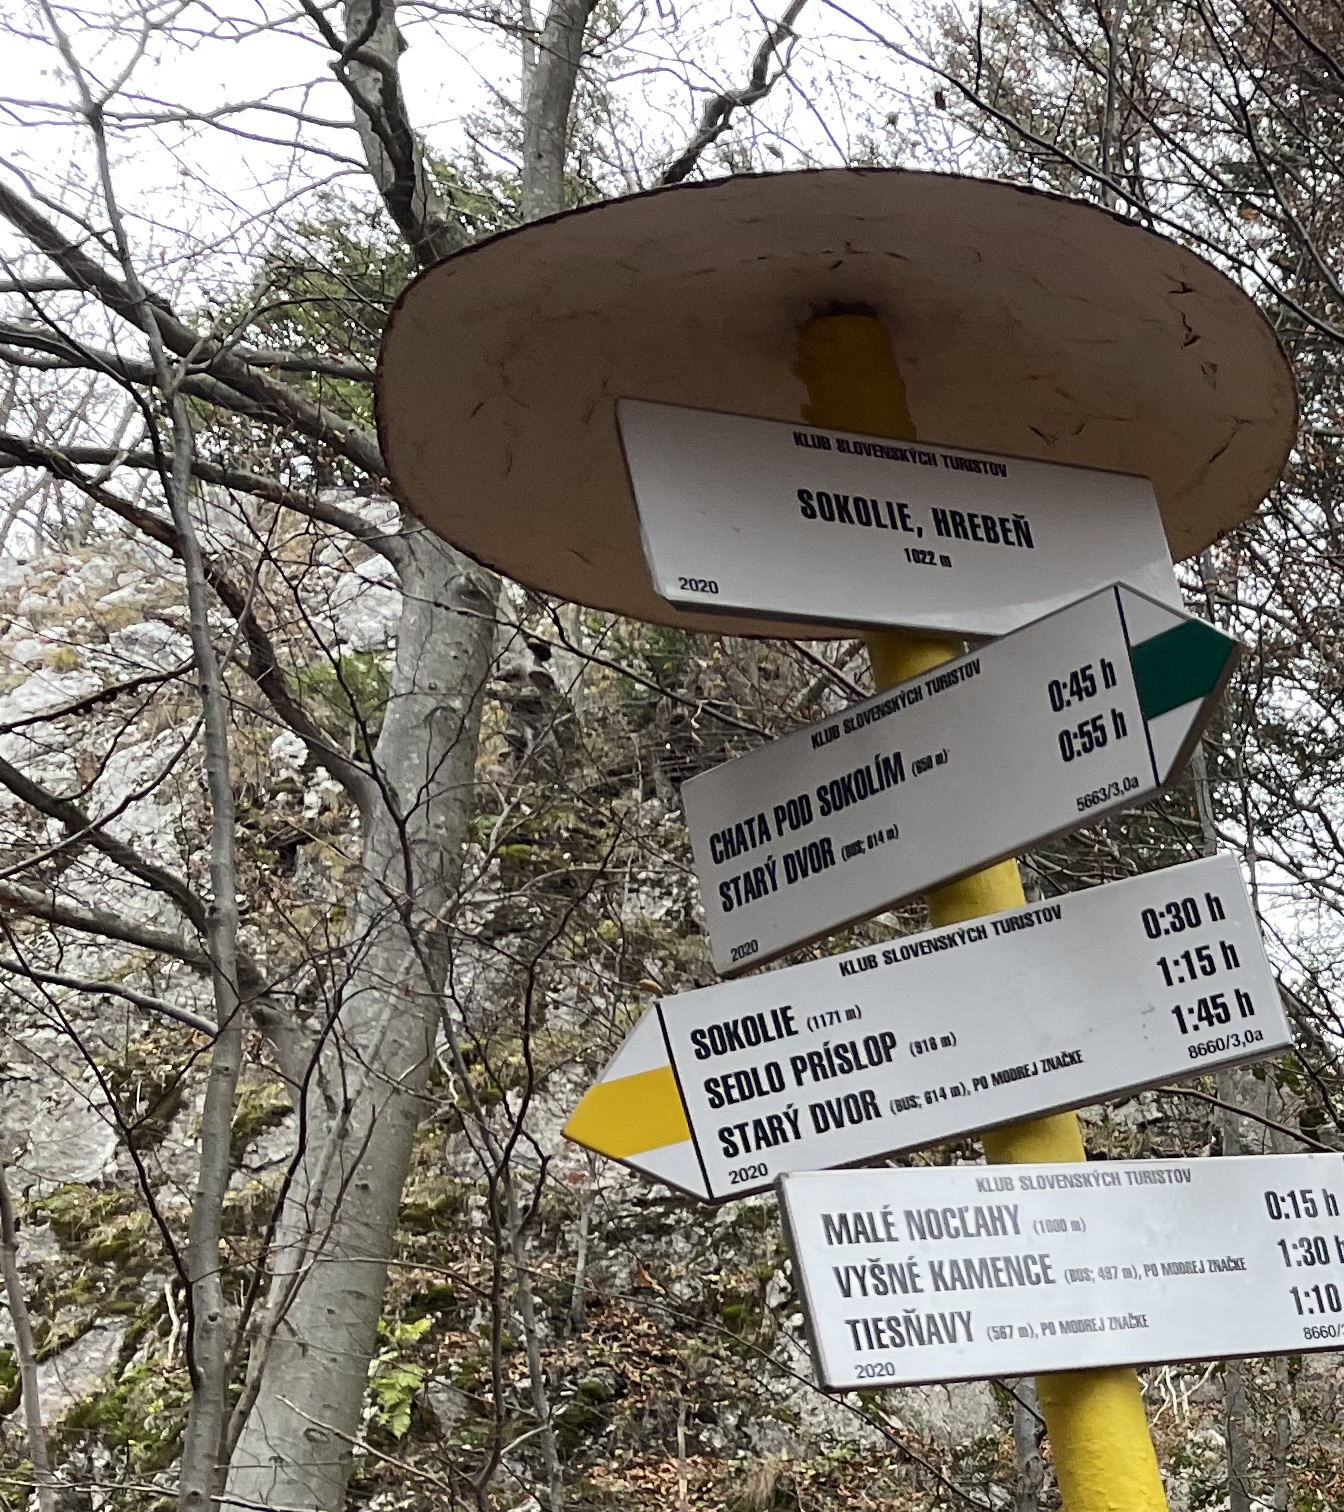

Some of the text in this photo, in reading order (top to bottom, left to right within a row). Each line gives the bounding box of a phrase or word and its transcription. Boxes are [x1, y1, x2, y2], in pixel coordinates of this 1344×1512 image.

[793, 431, 1007, 477] KLUB SLOVENSKÝCH TURISTOV
[797, 488, 1034, 548] SOKOLIE, HREBEŇ
[904, 548, 952, 568] 1022 m
[678, 576, 719, 594] 2020
[811, 658, 981, 750] KLUB SLOVENSKÝCH TURISTOV
[1048, 658, 1117, 712] 0:45 h
[1058, 708, 1128, 762] 0:55 h
[709, 812, 772, 865] CHATA
[773, 794, 813, 837] POD
[816, 751, 906, 817] SOKOLÍM
[1076, 776, 1140, 812] 5663/3,0a
[719, 855, 779, 912] STARÝ
[783, 837, 836, 884] DVOR
[1141, 892, 1226, 939] 0:30 h
[730, 939, 760, 962] 2020
[839, 904, 1062, 977] KLUB SLOVENSKÝCH TURISTOV
[1156, 940, 1240, 987] 1:15 h
[690, 1005, 799, 1060] SOKOLIE
[806, 1010, 842, 1032] (1171
[1171, 988, 1255, 1034] 1:45 h
[1188, 1029, 1264, 1059] 8660/3,0a
[704, 1061, 786, 1109] SEDLO
[789, 1031, 897, 1087] PRÍSLOP
[718, 1102, 802, 1158] STARÝ
[808, 1089, 882, 1134] DVOR
[972, 1077, 989, 1092] PO
[990, 1062, 1038, 1088] MODREJ
[1040, 1049, 1085, 1074] ZNAČKE
[728, 1162, 768, 1185] 2020
[975, 1168, 1192, 1193] KLUB SLOVENSKÝCH TURISTOV
[820, 1204, 899, 1246] MALÉ
[903, 1204, 1021, 1241] NOCĽAHY
[1264, 1188, 1340, 1220] 0:15 h
[1277, 1236, 1330, 1267] 1:30
[832, 1256, 924, 1298] VYŠNÉ
[928, 1253, 1056, 1292] KAMENCE
[1143, 1263, 1159, 1278] PO
[1160, 1259, 1205, 1276] MODREJ
[1207, 1256, 1247, 1273] ZNAČKE
[1289, 1283, 1342, 1315] 1:10
[844, 1308, 974, 1351] TIESŇAVY
[1040, 1321, 1057, 1336] PO
[1059, 1317, 1105, 1335] MODREJ
[1107, 1312, 1149, 1331] ZNAČKE
[854, 1362, 895, 1379] 2020
